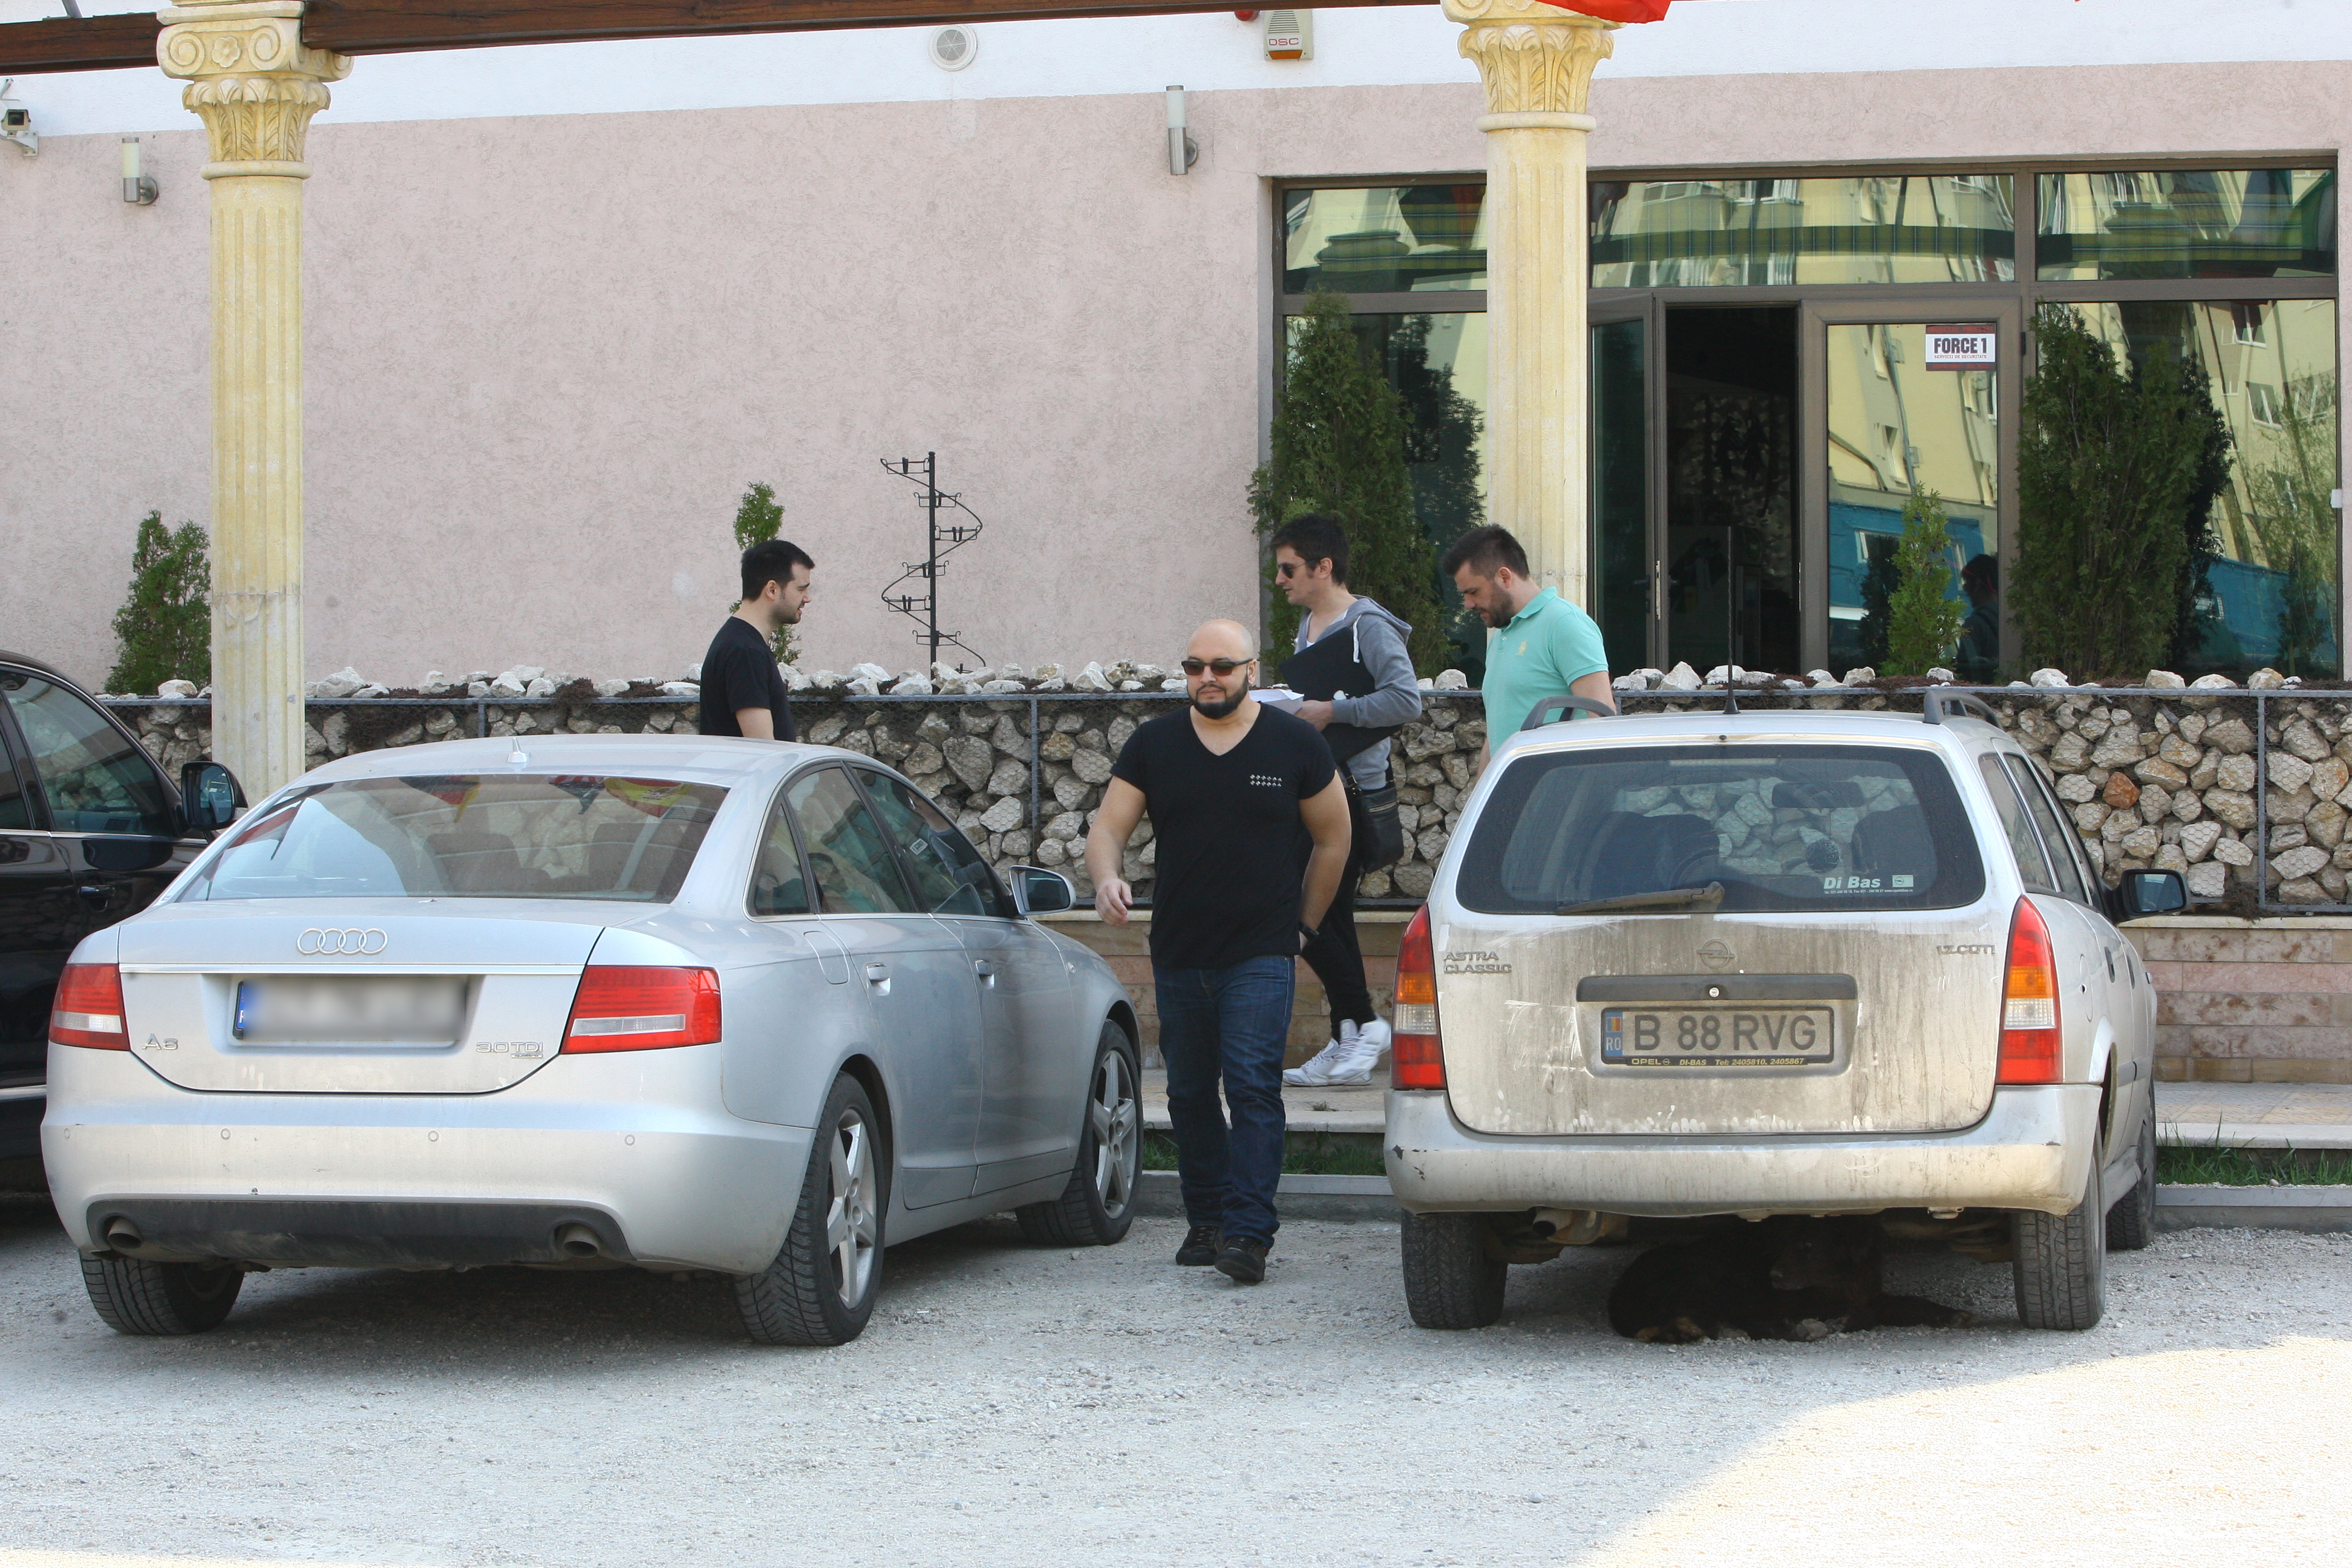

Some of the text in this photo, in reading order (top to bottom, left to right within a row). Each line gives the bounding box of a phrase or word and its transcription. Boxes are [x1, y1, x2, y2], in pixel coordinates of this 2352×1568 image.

[1269, 38, 1299, 46] DSC
[1933, 338, 1987, 354] FORCE 1
[1823, 876, 1881, 889] Di Bas
[1444, 952, 1499, 961] ASTRA
[1444, 964, 1512, 973] CLASSIC
[1635, 1014, 1816, 1051] B 88 RVG
[142, 1033, 178, 1050] A6
[1606, 1037, 1621, 1051] RO
